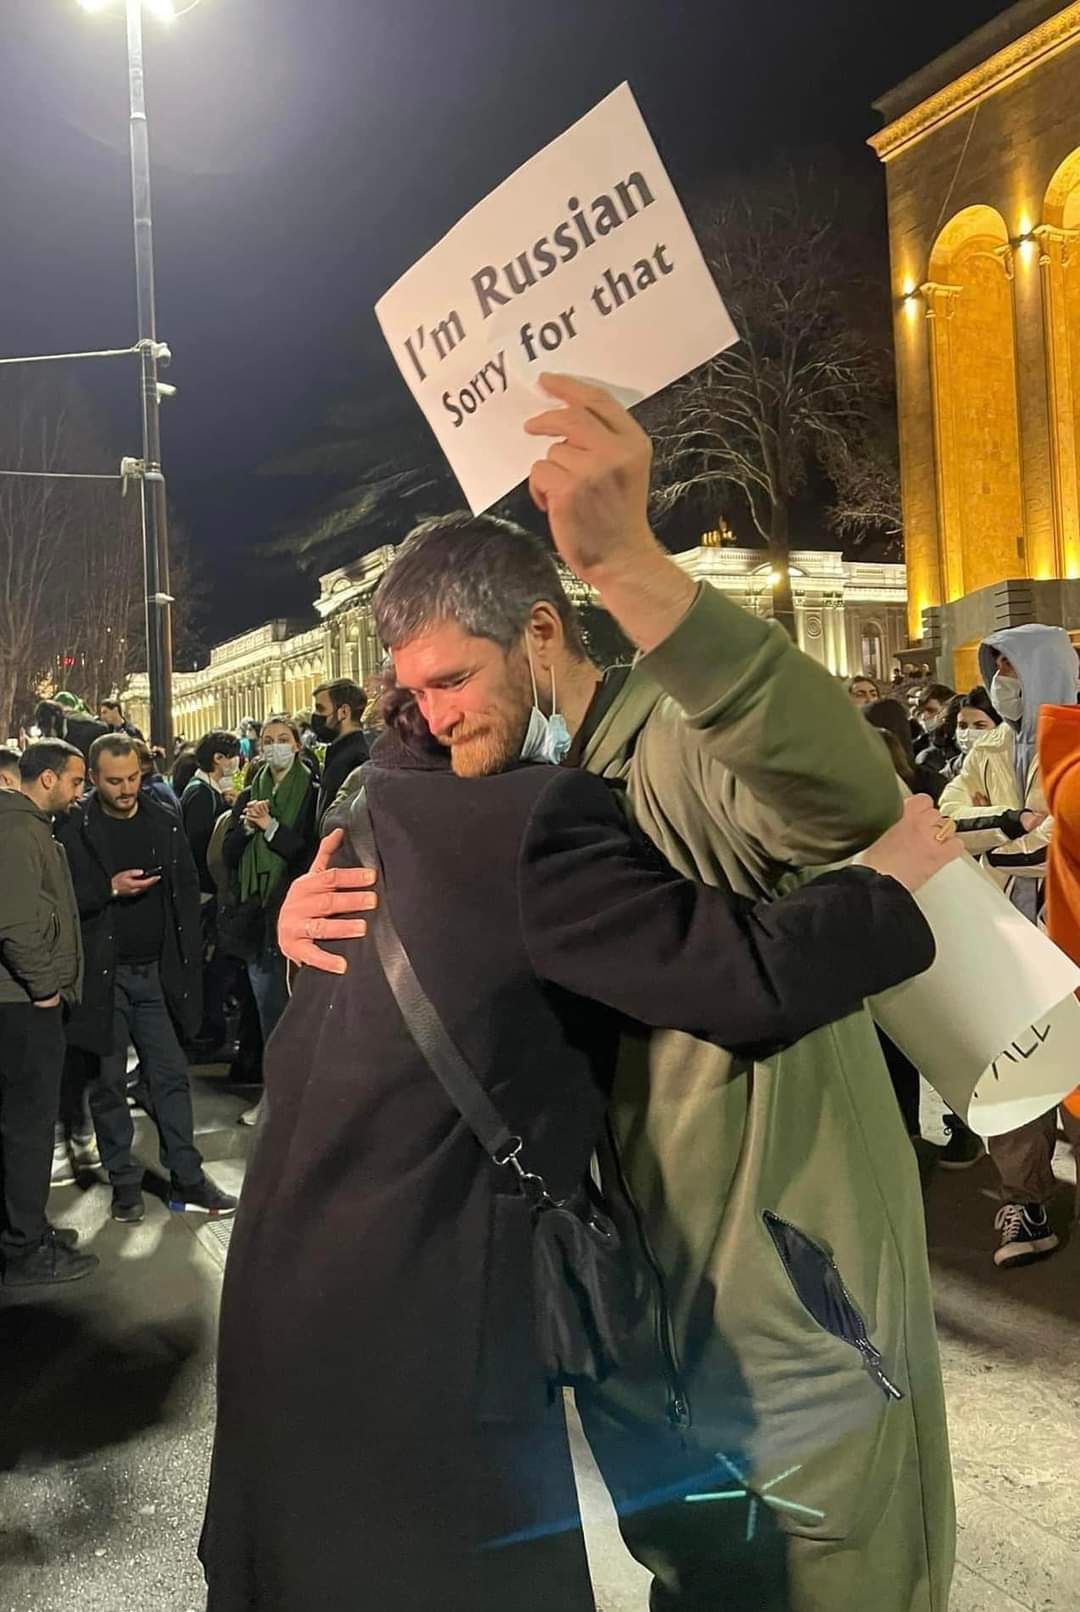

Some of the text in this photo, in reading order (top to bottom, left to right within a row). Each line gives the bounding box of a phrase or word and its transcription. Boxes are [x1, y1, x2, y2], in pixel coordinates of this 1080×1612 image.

[403, 170, 656, 383] I'm Russian
[442, 242, 674, 428] Sorry for that
